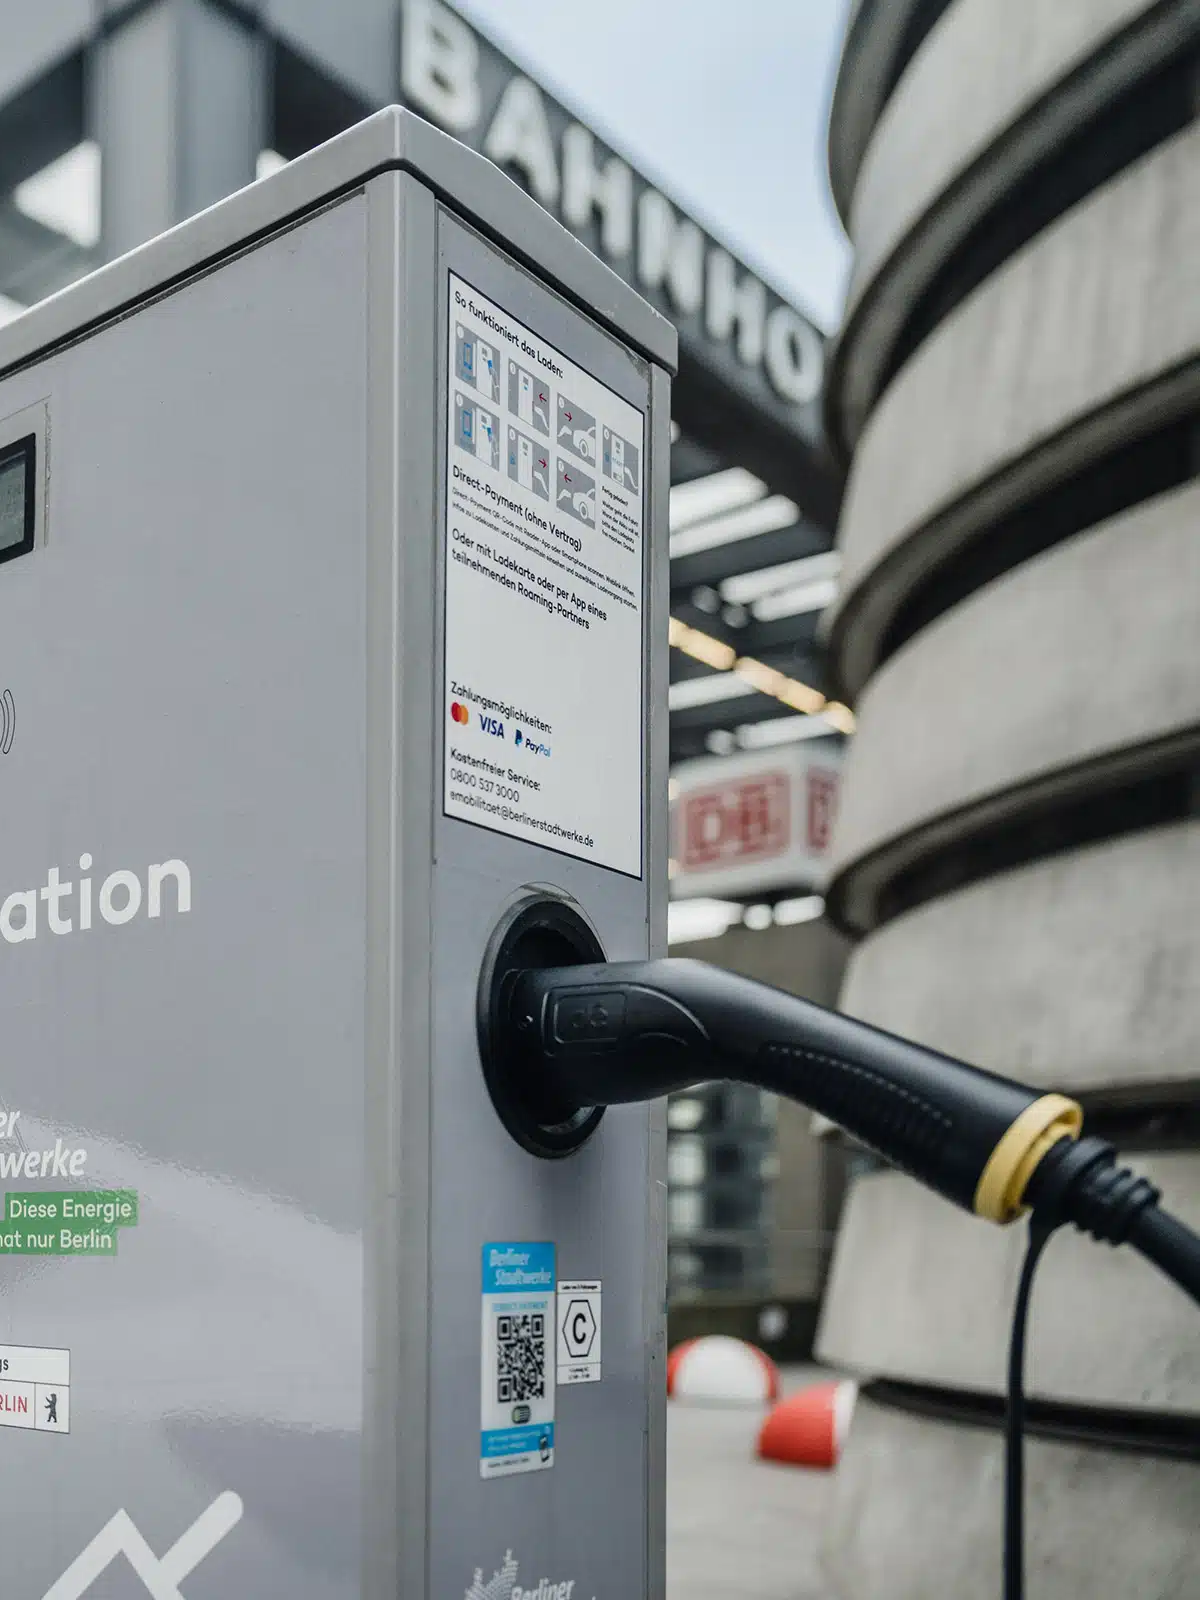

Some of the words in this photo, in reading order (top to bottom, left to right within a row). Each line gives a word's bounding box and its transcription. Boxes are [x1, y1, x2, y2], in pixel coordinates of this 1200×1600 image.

[454, 290, 467, 308] So
[468, 300, 520, 348] funktioniert
[520, 339, 536, 360] das
[537, 350, 564, 379] Laden:
[452, 464, 524, 517] Direct-Payment
[524, 507, 548, 531] (ohne
[549, 520, 582, 553] Vertrag)
[451, 547, 516, 592] teilnehmenden
[517, 581, 590, 630] Roaming-Partners
[452, 527, 475, 549] Oder
[476, 543, 492, 559] mit
[493, 548, 536, 582] Ladekarte
[536, 577, 555, 593] oder
[556, 586, 570, 600] per
[570, 592, 587, 612] App
[587, 602, 607, 621] eines
[450, 680, 553, 735] Zahlungsmöglichkeiten:
[478, 713, 505, 740] VISA
[450, 746, 506, 778] Kostenfreier
[507, 768, 542, 792] Service:
[525, 738, 552, 758] PayPal
[450, 767, 477, 788] 0800
[478, 776, 495, 793] 537
[495, 783, 520, 803] 3000
[450, 790, 594, 848] emobilitaet@berlinerstadtwerke.de
[9, 1198, 58, 1219] Diese
[62, 1197, 133, 1224] Energie
[26, 1233, 56, 1249] nur
[59, 1227, 113, 1249] Berlin
[572, 1312, 587, 1345] C
